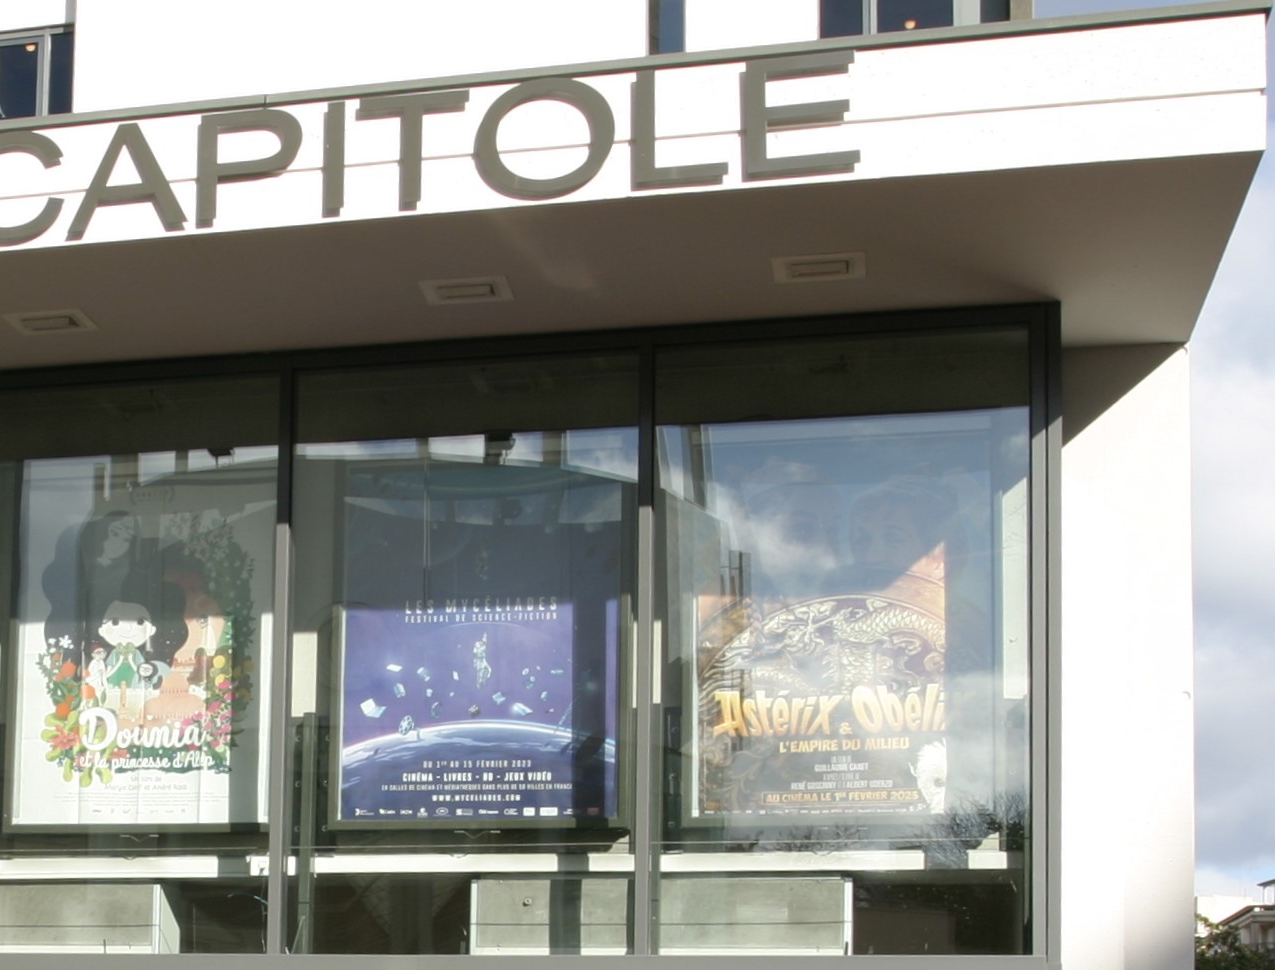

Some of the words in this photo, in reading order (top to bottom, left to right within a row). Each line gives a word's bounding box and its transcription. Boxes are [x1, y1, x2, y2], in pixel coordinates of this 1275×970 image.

[405, 600, 434, 614] LES
[445, 596, 557, 613] MYCÉLIADES
[405, 615, 449, 623] FESTIVAL
[455, 614, 465, 622] DE
[713, 690, 844, 737] Astérix
[839, 722, 853, 735] &
[851, 684, 946, 734] Obéli
[79, 707, 207, 751] Dounia
[779, 739, 838, 754] L'EMPIRE
[842, 739, 861, 751] DU
[864, 737, 910, 750] MILIEU
[79, 751, 93, 768] et
[95, 751, 110, 769] la
[110, 753, 171, 774] princesse
[402, 772, 433, 782] CINÉMA
[443, 772, 472, 782] LIVRES
[504, 772, 525, 781] JEUX
[528, 771, 552, 781] VIDÉO
